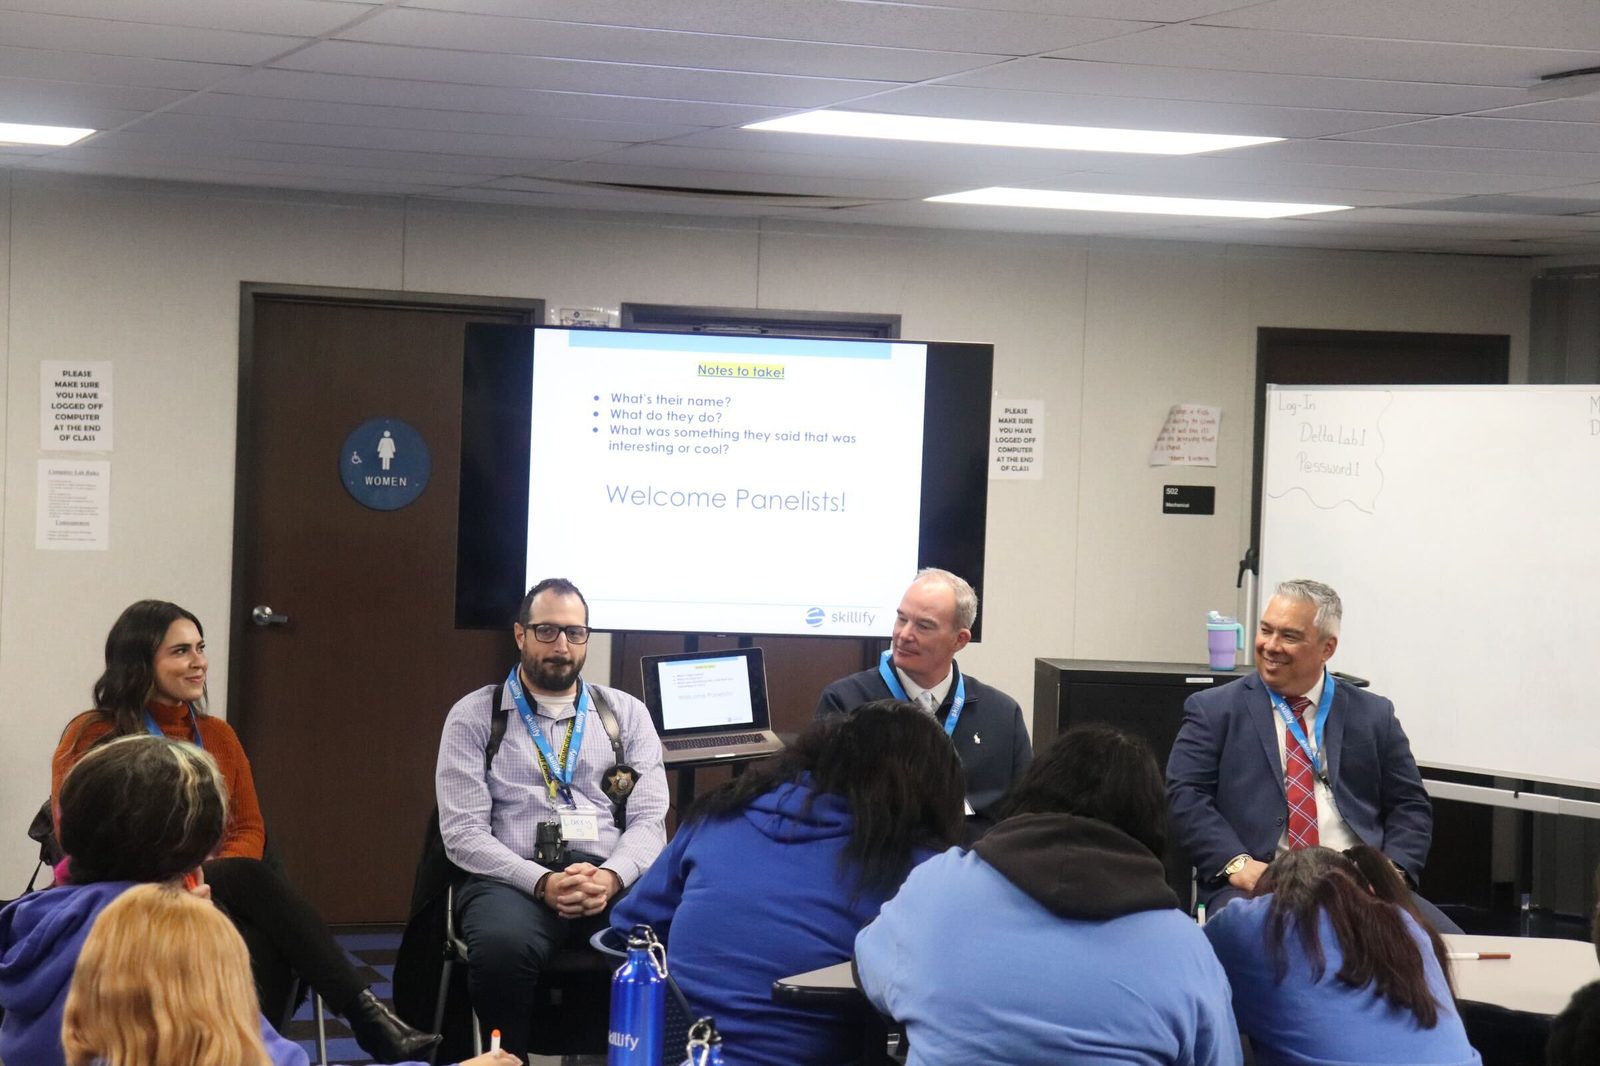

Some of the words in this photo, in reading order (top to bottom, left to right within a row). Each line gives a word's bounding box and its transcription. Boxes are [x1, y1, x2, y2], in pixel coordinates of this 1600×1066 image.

[698, 364, 733, 376] Notes
[737, 366, 749, 377] to
[753, 367, 785, 378] take!
[51, 402, 86, 410] LOGGED
[611, 393, 653, 405] What's
[656, 394, 683, 405] their
[687, 396, 732, 407] name?
[1279, 392, 1316, 416] Log-In
[55, 413, 100, 421] COMPUTER
[610, 408, 642, 420] What
[646, 410, 663, 421] do
[667, 411, 695, 424] they
[698, 412, 722, 423] do?
[610, 424, 641, 436] What
[645, 427, 670, 437] was
[674, 427, 740, 442] something
[744, 430, 771, 442] they
[775, 431, 800, 442] said
[804, 432, 828, 442] that
[832, 434, 856, 444] was
[608, 440, 674, 456] interesting
[678, 445, 690, 453] or
[694, 443, 730, 455] cool?
[365, 475, 407, 487] WOMEN
[606, 484, 727, 509] Welcome
[736, 487, 846, 513] Panelists!
[831, 611, 876, 626] skillify
[1278, 702, 1294, 725] skillify
[525, 713, 540, 737] skillify
[546, 752, 561, 774] skillify
